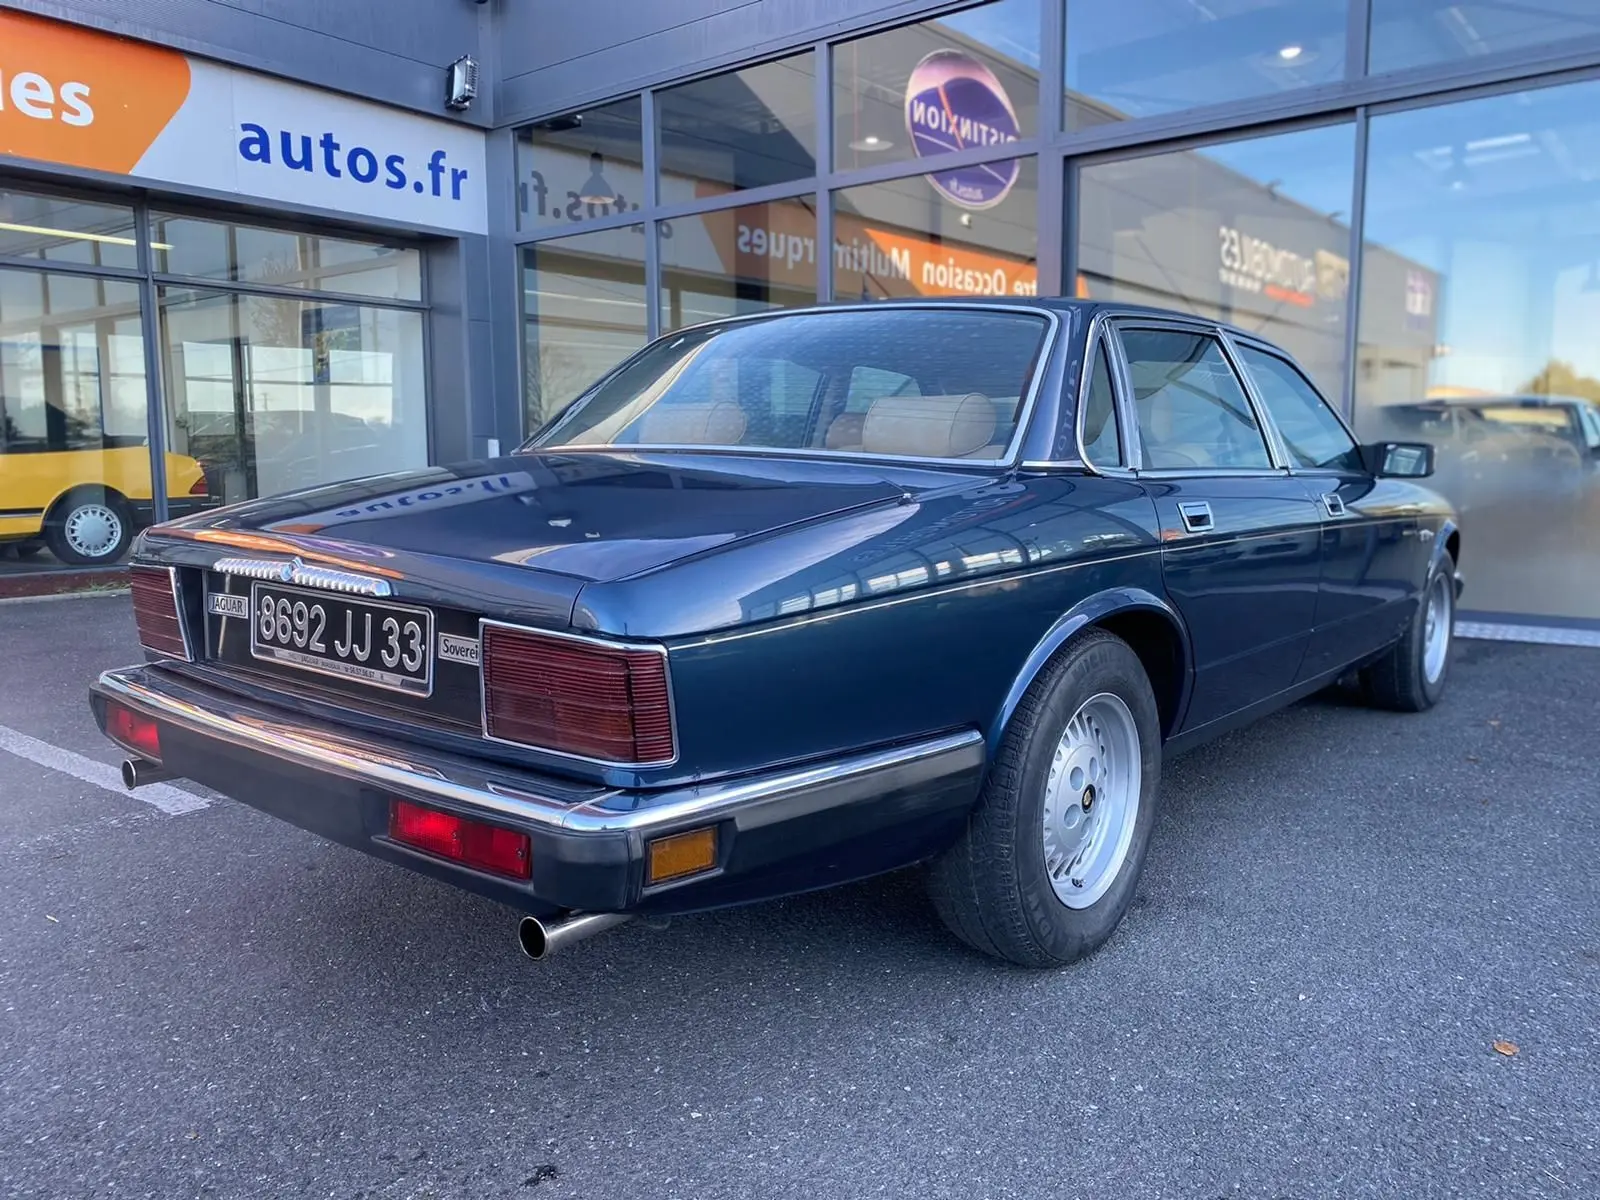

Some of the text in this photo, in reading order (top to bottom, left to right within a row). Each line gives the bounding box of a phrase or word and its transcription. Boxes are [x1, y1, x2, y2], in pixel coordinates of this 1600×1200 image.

[0, 68, 94, 127] es
[238, 122, 468, 201] autos.fr
[211, 596, 244, 614] JAGUAR
[259, 594, 423, 673] 8692 JJ 33
[442, 638, 479, 660] Soverei
